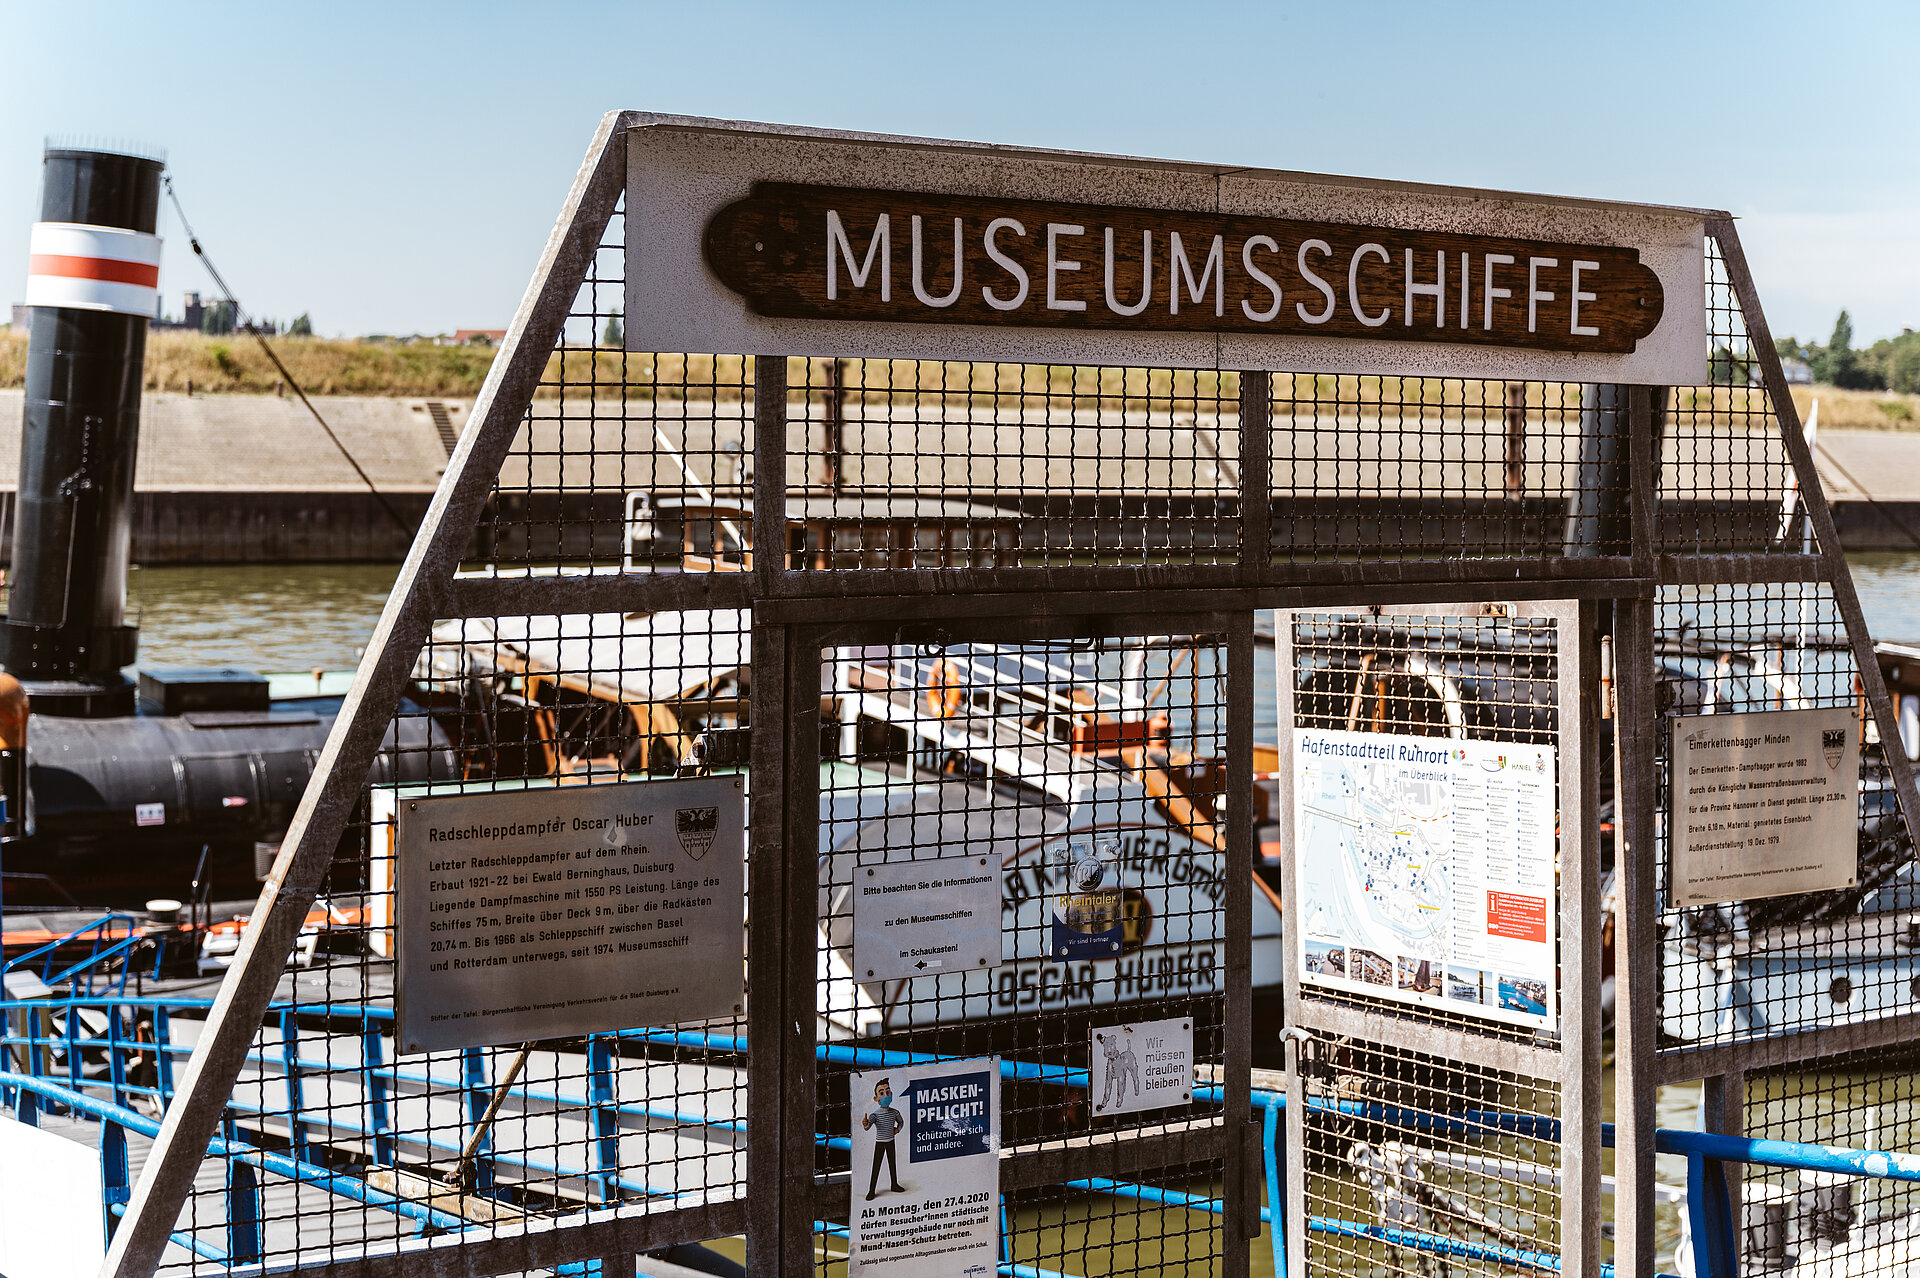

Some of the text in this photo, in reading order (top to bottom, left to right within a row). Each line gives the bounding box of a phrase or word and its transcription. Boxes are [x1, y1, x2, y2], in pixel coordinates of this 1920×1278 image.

[826, 208, 1601, 338] MUSEUMSSCHIFFE
[1302, 738, 1449, 765] Hafenstadtteil Ruhrort
[1689, 734, 1791, 750] Eimerkettenbagger Minden
[1399, 768, 1448, 782] im Überblick
[1689, 766, 1699, 775] Der
[1777, 760, 1794, 768] wurde
[1689, 786, 1705, 795] durch
[1707, 785, 1716, 793] die
[1719, 782, 1746, 793] Königliche
[1689, 805, 1697, 814] für
[1700, 805, 1708, 813] die
[1710, 803, 1731, 812] Provinz
[1733, 801, 1758, 810] Hannover
[1768, 798, 1784, 807] Dienst
[1809, 795, 1825, 804] Länge
[429, 813, 654, 842] Radschleppdampfer Oscar Huber
[1688, 825, 1705, 833] Breite
[1753, 818, 1782, 829] genietetes
[429, 844, 650, 872] Letzter Radschleppdampfer auf dem Rhein.
[430, 880, 464, 892] Erbaut
[513, 873, 528, 884] bei
[532, 871, 562, 883] Ewald
[567, 867, 630, 880] Berninghaus,
[863, 875, 993, 895] Bitte beachten Sie die Informationen
[430, 877, 720, 913] Liegende Dampfmaschine mit 1550 PS Leistung. Länge des
[1059, 892, 1116, 908] Rheintaler
[430, 919, 472, 932] Schiffes
[505, 913, 535, 925] Breite
[540, 911, 563, 922] über
[567, 907, 591, 919] Deck
[617, 904, 640, 914] über
[644, 901, 658, 912] die
[662, 896, 712, 910] Radkästen
[895, 917, 909, 926] den
[911, 910, 973, 924] Museumsschiffen
[475, 936, 490, 948] Bis
[494, 934, 516, 946] 1966
[520, 932, 535, 943] als
[539, 925, 605, 941] Schleppschiff
[609, 921, 653, 934] zwischen
[657, 917, 684, 929] Basel
[430, 936, 689, 972] und Rotterdam unterwegs, seit 1974 Museumsschiff
[900, 944, 958, 958] im Schaukasten!
[998, 952, 1214, 1008] OSCAR HUBER
[646, 989, 669, 997] Duisburg
[1145, 1037, 1163, 1049] Wir
[1145, 1050, 1185, 1063] müssen
[1145, 1063, 1185, 1076] draußen
[916, 1083, 984, 1104] MASKEN-
[917, 1100, 984, 1124] PFLICHT!
[917, 1124, 984, 1142] Schützen Sie sich
[917, 1140, 964, 1153] und andere.
[861, 1192, 990, 1219] Ab Montag, den 27.4.2020
[860, 1219, 887, 1230] dürfen
[951, 1205, 990, 1217] städtische
[860, 1215, 989, 1241] Verwaltungsgebäude nur noch mit
[860, 1229, 973, 1252] Mund-Nasen-Schutz betreten.
[860, 1257, 878, 1266] Zulässig
[879, 1255, 889, 1263] sind
[889, 1253, 914, 1262] sogenannte
[915, 1247, 947, 1258] Alltagsmasken
